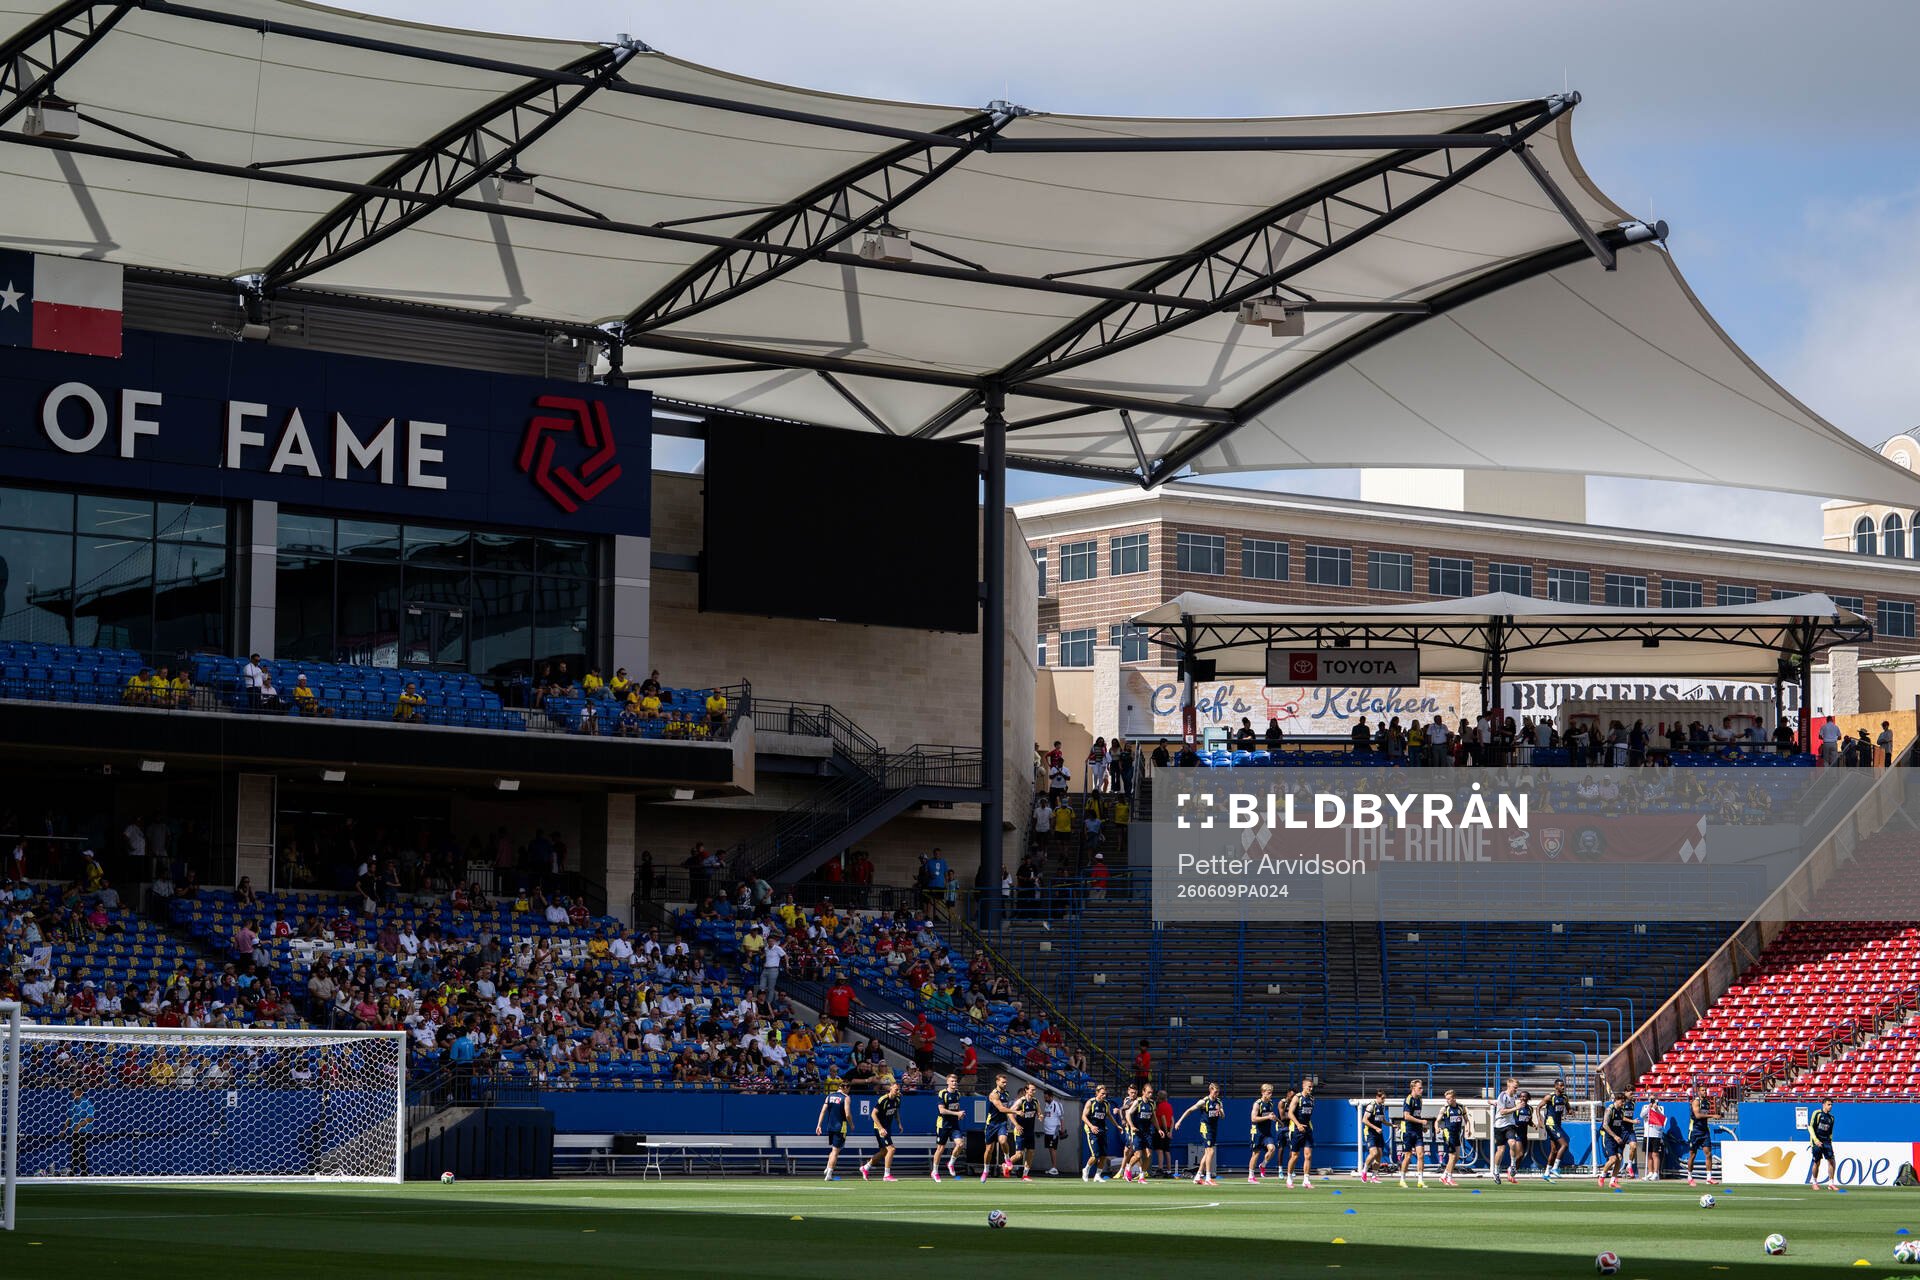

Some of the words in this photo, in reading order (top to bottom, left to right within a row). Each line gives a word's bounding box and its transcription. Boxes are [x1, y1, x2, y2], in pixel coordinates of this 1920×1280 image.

[42, 382, 162, 458] OF
[226, 400, 448, 490] FAME
[1322, 660, 1398, 675] TOYOTA
[1151, 683, 1252, 723] Cef's
[1312, 687, 1440, 719] Kitchen
[1511, 683, 1679, 710] BURGERS
[1339, 823, 1395, 861] THE
[1404, 823, 1492, 862] RHINE
